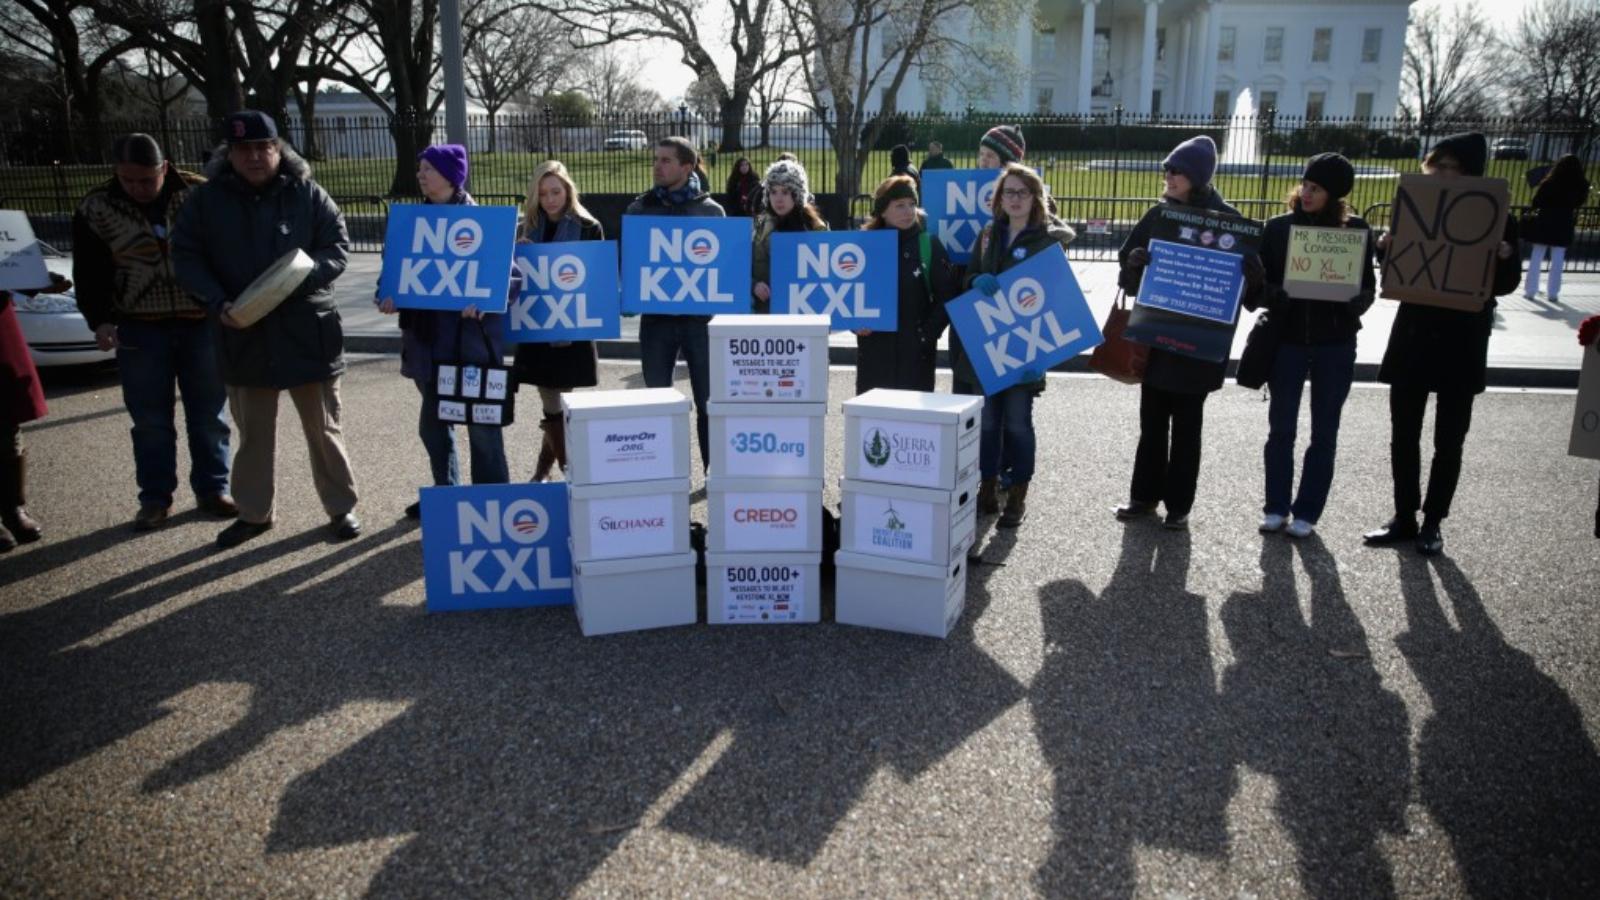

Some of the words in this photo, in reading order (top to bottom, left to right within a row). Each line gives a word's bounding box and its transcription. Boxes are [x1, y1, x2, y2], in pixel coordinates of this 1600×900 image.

[1160, 209, 1203, 225] FORWARD
[1205, 218, 1218, 228] ON
[1221, 220, 1260, 237] CLIMATE
[1390, 186, 1499, 246] NO
[412, 216, 483, 257] NO
[650, 228, 720, 265] NO
[398, 257, 491, 298] KXL
[517, 254, 586, 291] NO
[797, 243, 866, 280] NO
[1291, 255, 1312, 272] NO
[1320, 257, 1336, 273] XL
[1383, 241, 1493, 297] KXL!
[640, 266, 734, 302] KXL
[789, 282, 880, 318] KXL
[510, 293, 603, 331] KXL
[974, 277, 1045, 336] NO
[729, 338, 806, 357] 500,000+
[983, 311, 1082, 378] KXL
[488, 382, 503, 391] NO
[440, 406, 464, 417] KXL
[604, 431, 656, 443] MoveOn
[617, 442, 644, 452] .ORG
[892, 433, 936, 452] SIERRA
[894, 449, 931, 466] CLUB
[456, 499, 549, 545] NO
[734, 508, 798, 523] CREDO
[872, 534, 913, 549] COALITION
[448, 547, 572, 595] KXL
[727, 567, 800, 583] 500,000+
